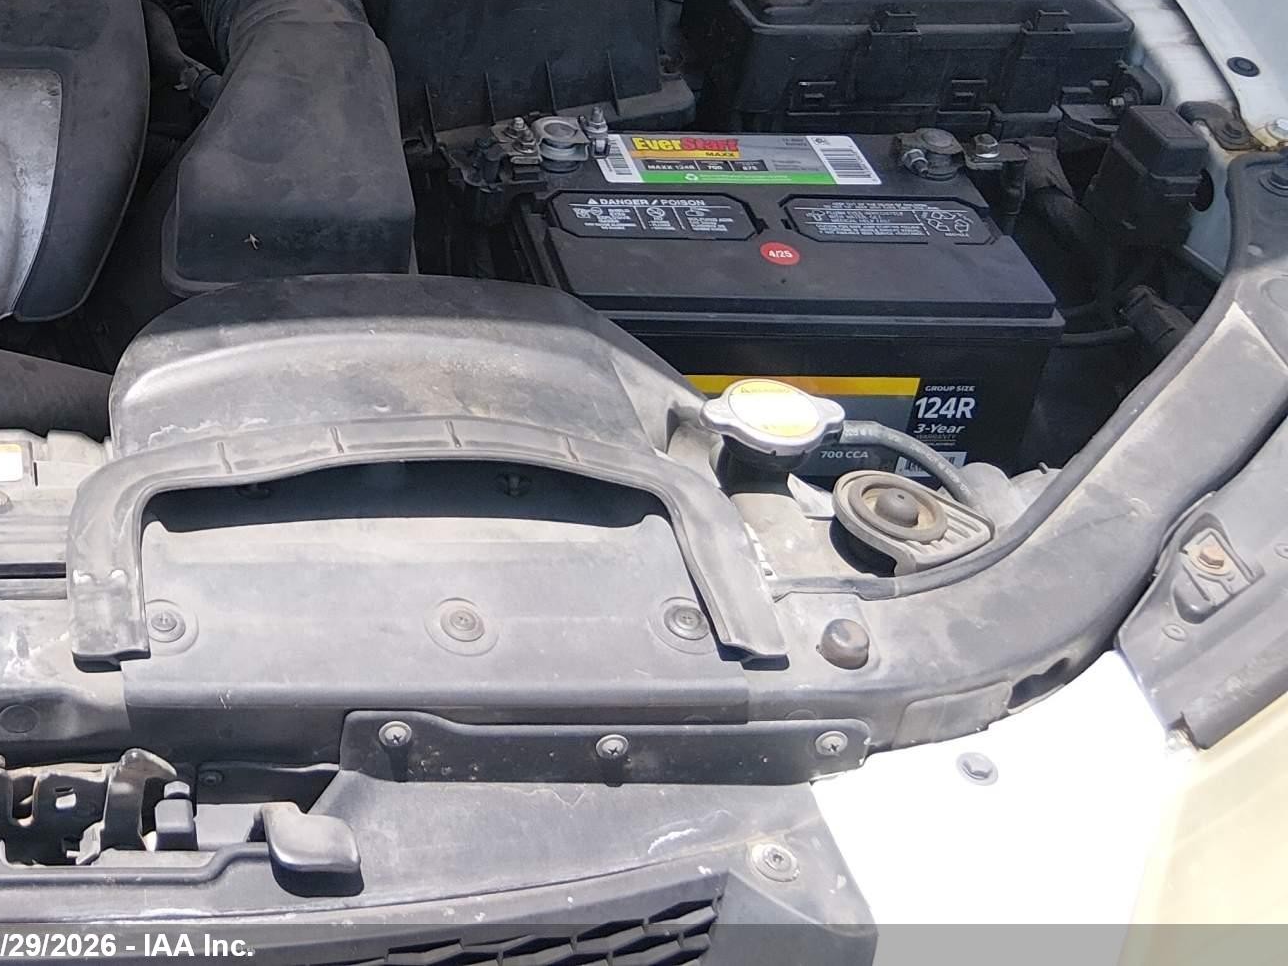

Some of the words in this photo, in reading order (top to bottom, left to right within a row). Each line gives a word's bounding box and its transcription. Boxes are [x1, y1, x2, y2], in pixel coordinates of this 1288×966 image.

[631, 136, 740, 152] EverStart
[600, 198, 649, 206] DANGER
[915, 396, 976, 419] 124R
[913, 423, 966, 434] 3-Year
[820, 450, 843, 459] 700
[845, 450, 869, 459] CCA
